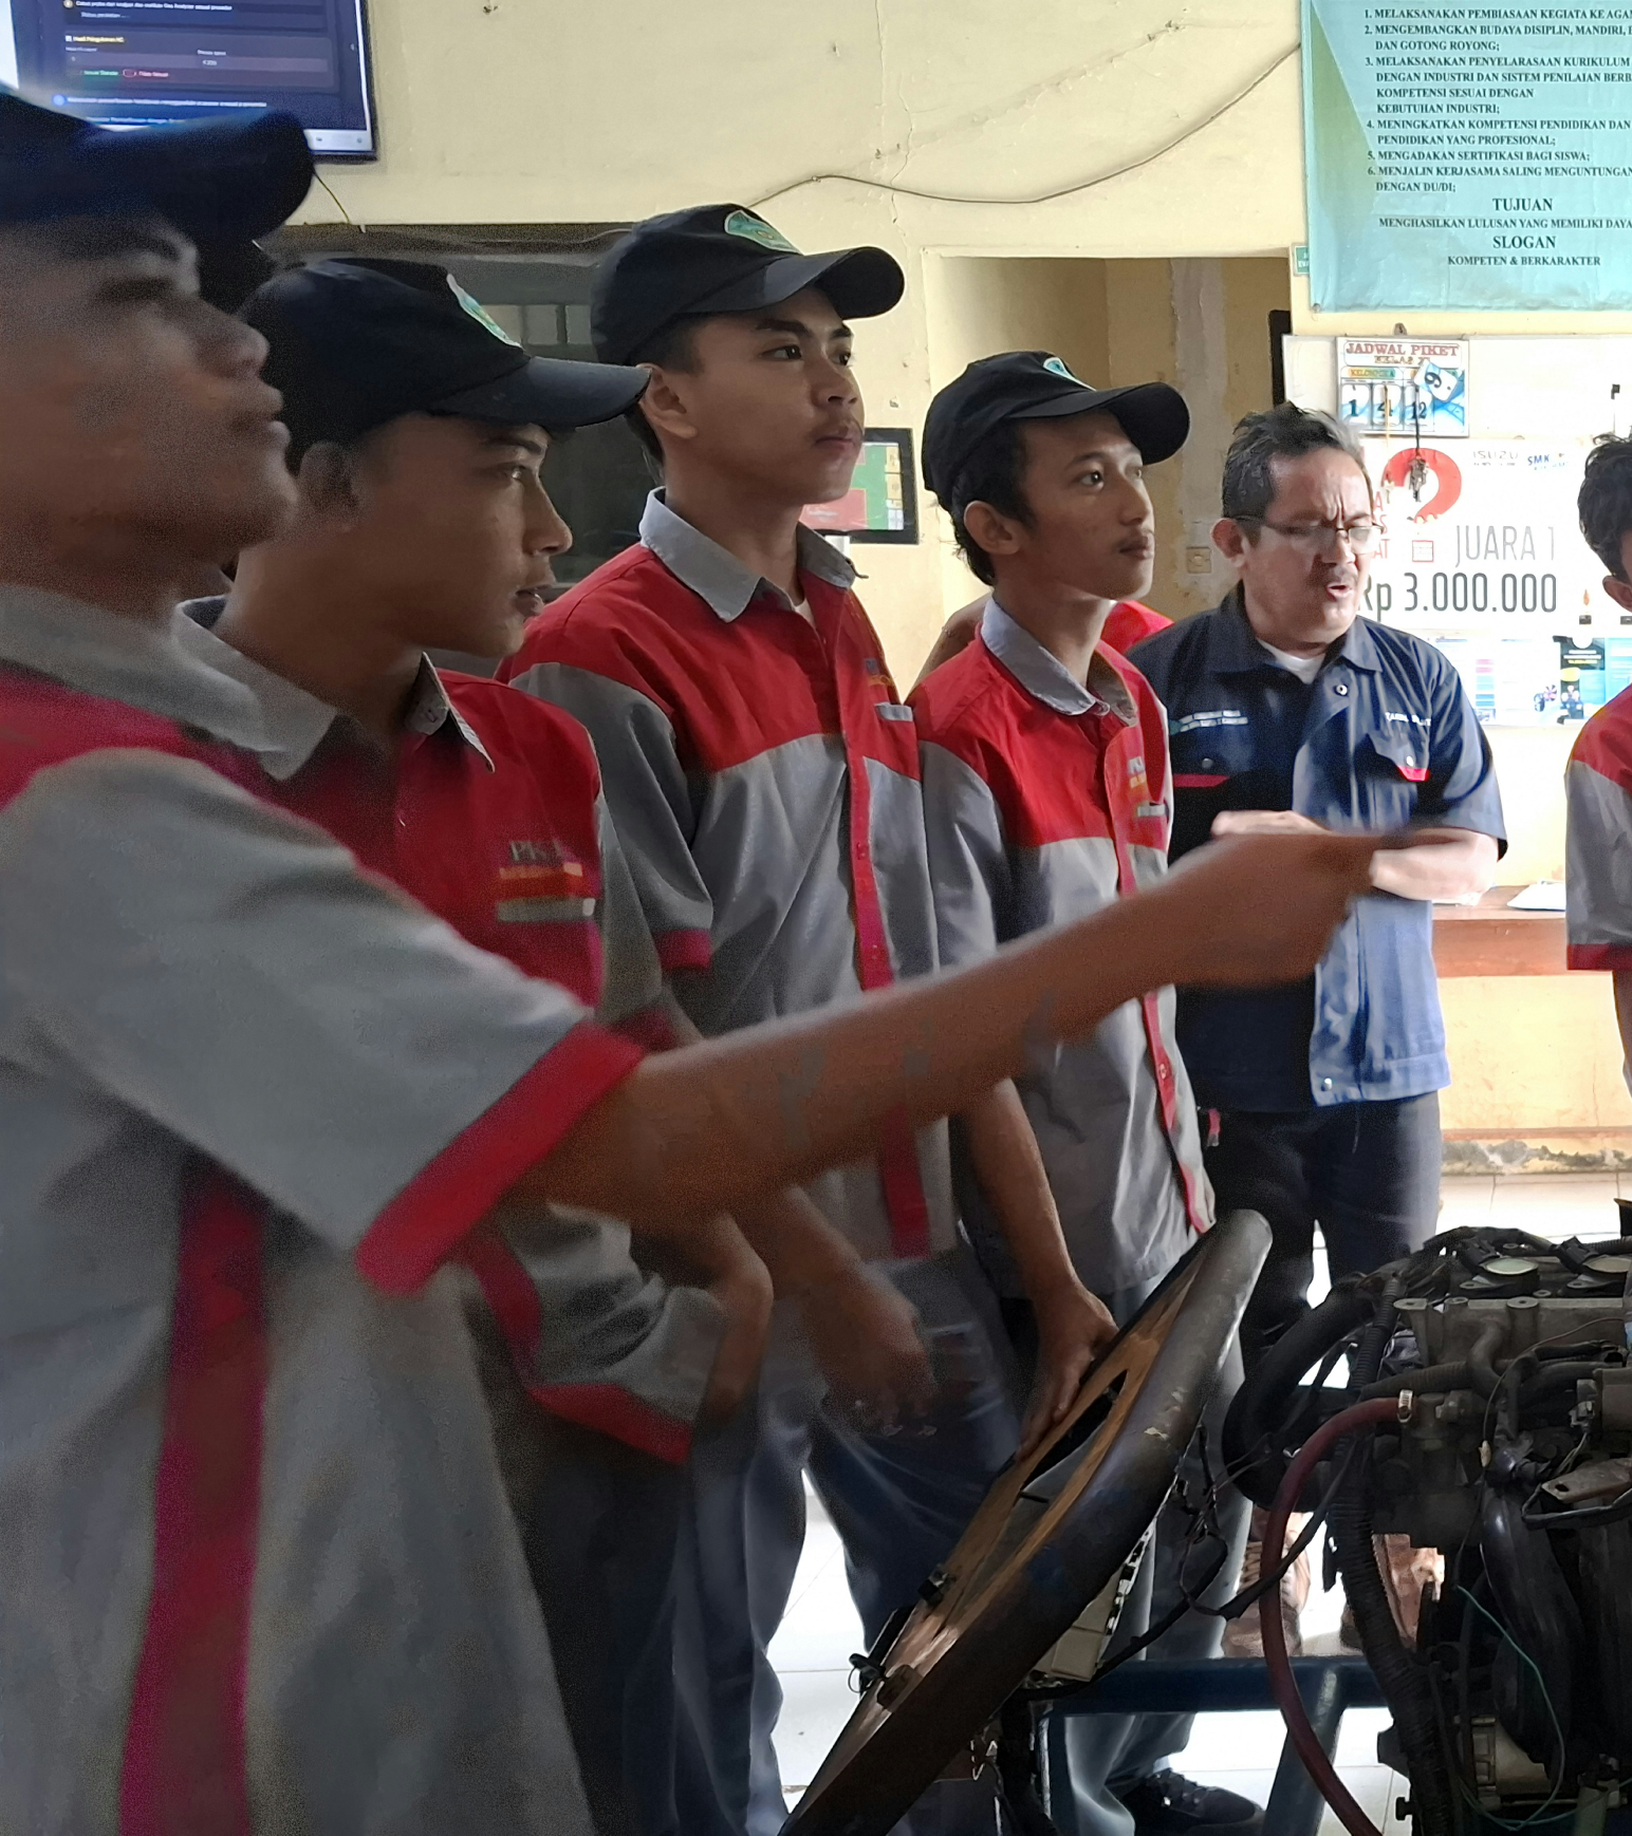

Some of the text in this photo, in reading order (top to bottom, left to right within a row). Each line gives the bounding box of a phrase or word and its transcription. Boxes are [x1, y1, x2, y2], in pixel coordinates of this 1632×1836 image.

[1364, 9, 1372, 19] 1.
[1374, 9, 1466, 19] MELAKSANAKAN
[1468, 9, 1538, 19] PEMBIASAAN
[1540, 9, 1588, 19] KEGIATA
[1590, 9, 1604, 19] KE
[1364, 25, 1372, 34] 2.
[1374, 25, 1478, 34] MENGEMBANGKAN
[1480, 25, 1522, 34] BUDAYA
[1524, 25, 1574, 36] DISIPLIN,
[1576, 25, 1626, 36] MANDIRI,
[1375, 40, 1500, 50] DAN GOTONG ROYONG;
[1365, 57, 1630, 66] 3. MELAKSANAKAN PENYELARASAAN KURIKULUM
[1376, 72, 1421, 82] DENGAN
[1424, 72, 1474, 82] INDUSTRI
[1476, 72, 1498, 82] DAN
[1502, 72, 1540, 82] SISTEM
[1543, 72, 1600, 82] PENILAIAN
[1376, 88, 1534, 98] KOMPETENSI SESUAI DENGAN
[1377, 104, 1500, 114] KEBUTUHAN INDUSTRI;
[1366, 120, 1374, 129] 4.
[1378, 120, 1466, 129] MENINGKATKAN
[1468, 120, 1537, 129] KOMPETENSI
[1540, 120, 1606, 129] PENDIDIKAN
[1608, 120, 1630, 129] DAN
[1378, 136, 1556, 145] PENDIDIKAN YANG PROFESIONAL;
[1368, 151, 1590, 160] 5. MENGADAKAN SERTIFIKASI BAGI SISWA;
[1368, 166, 1376, 176] 6.
[1378, 166, 1433, 176] MENJALIN
[1436, 166, 1500, 176] KERJASAMA
[1502, 166, 1542, 176] SALING
[1376, 182, 1456, 192] DENGAN DU/DI;
[1492, 198, 1554, 211] TUJUAN
[1379, 218, 1465, 228] MENGHASILKAN
[1468, 218, 1518, 228] LULUSAN
[1519, 218, 1548, 228] YANG
[1551, 218, 1604, 228] MEMILIKI
[1606, 218, 1632, 228] DAYA
[1492, 236, 1556, 249] SLOGAN
[1448, 256, 1601, 266] KOMPETEN & BERKARAKTER
[1346, 343, 1459, 356] JADWAL PIKET
[1349, 399, 1358, 417] 1
[1410, 400, 1428, 420] 12
[1527, 454, 1550, 466] SMK
[1455, 525, 1554, 568] JUARA 1
[1404, 572, 1556, 612] 3.000.000
